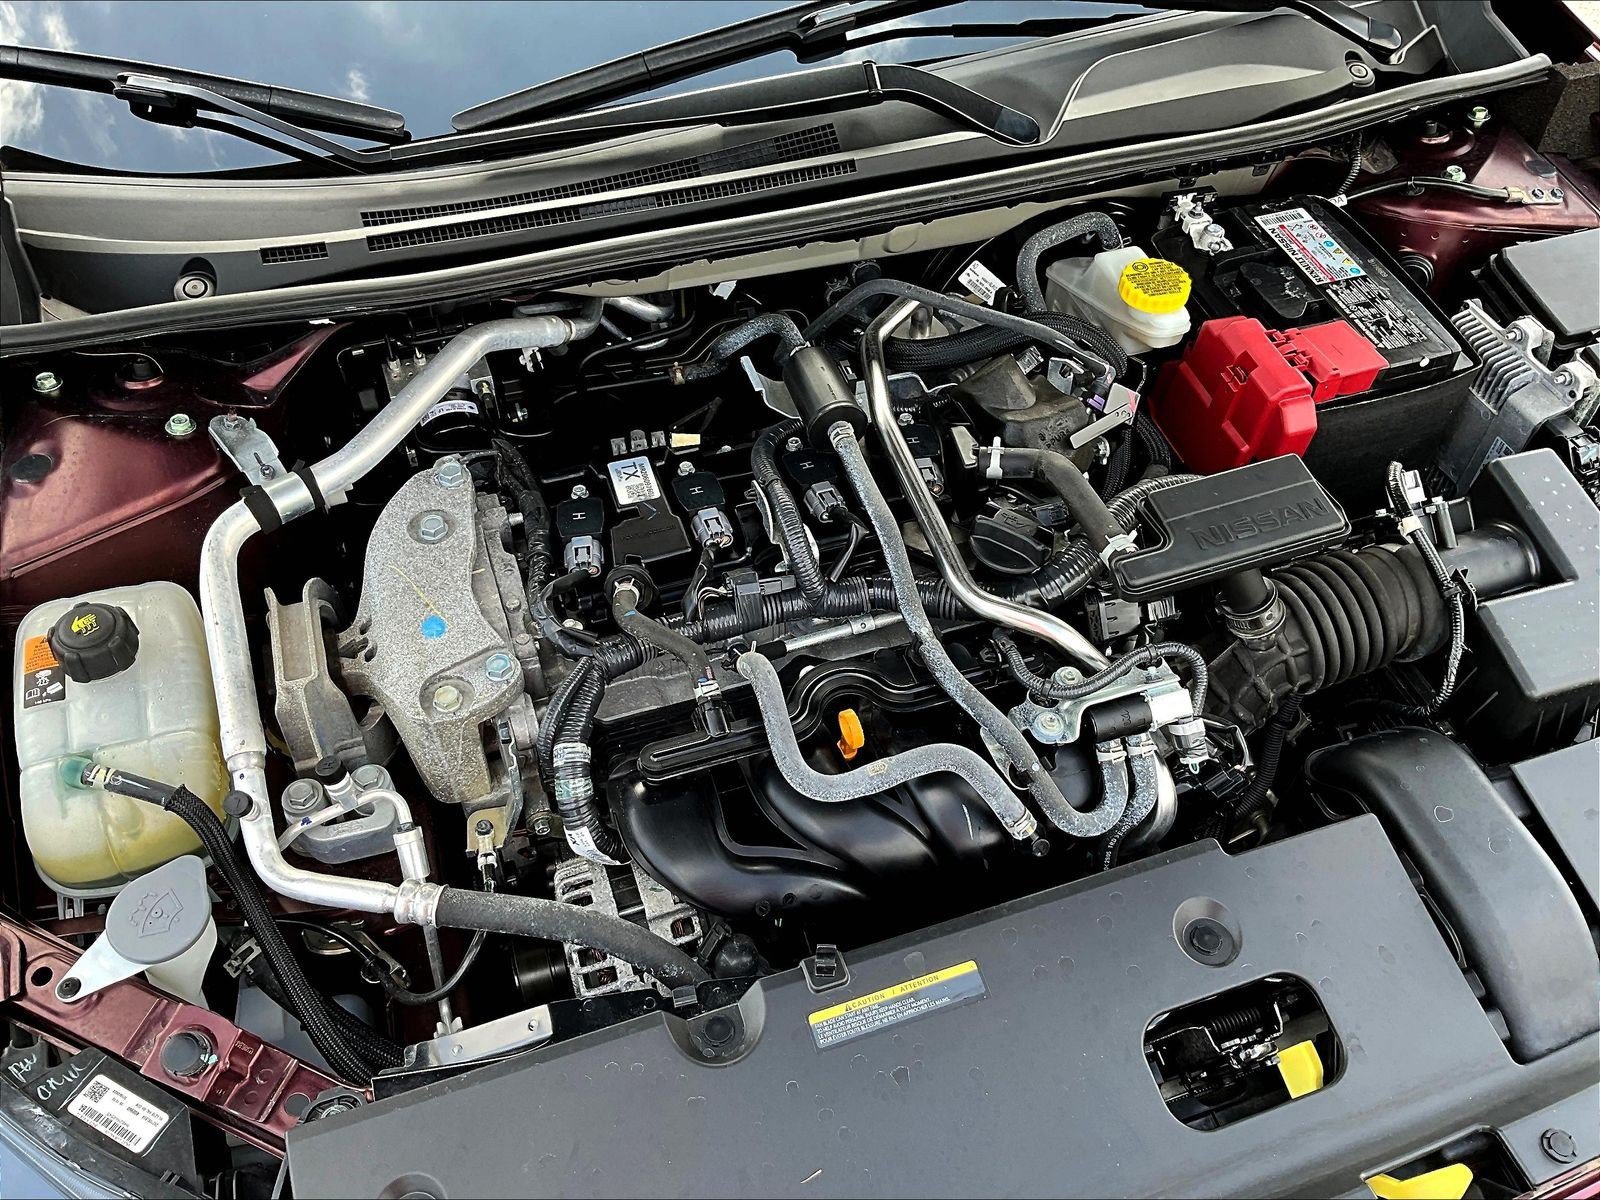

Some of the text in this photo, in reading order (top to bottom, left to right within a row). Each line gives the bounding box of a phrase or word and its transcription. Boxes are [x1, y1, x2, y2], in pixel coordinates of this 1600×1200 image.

[1269, 228, 1298, 258] NISSAN
[1297, 256, 1324, 284] RENAULT
[621, 462, 640, 480] TX
[1190, 498, 1330, 550] NISSAN
[852, 993, 885, 1008] CAUTION
[900, 975, 939, 992] ATTENTION
[824, 1025, 851, 1037] VENTILATEUR
